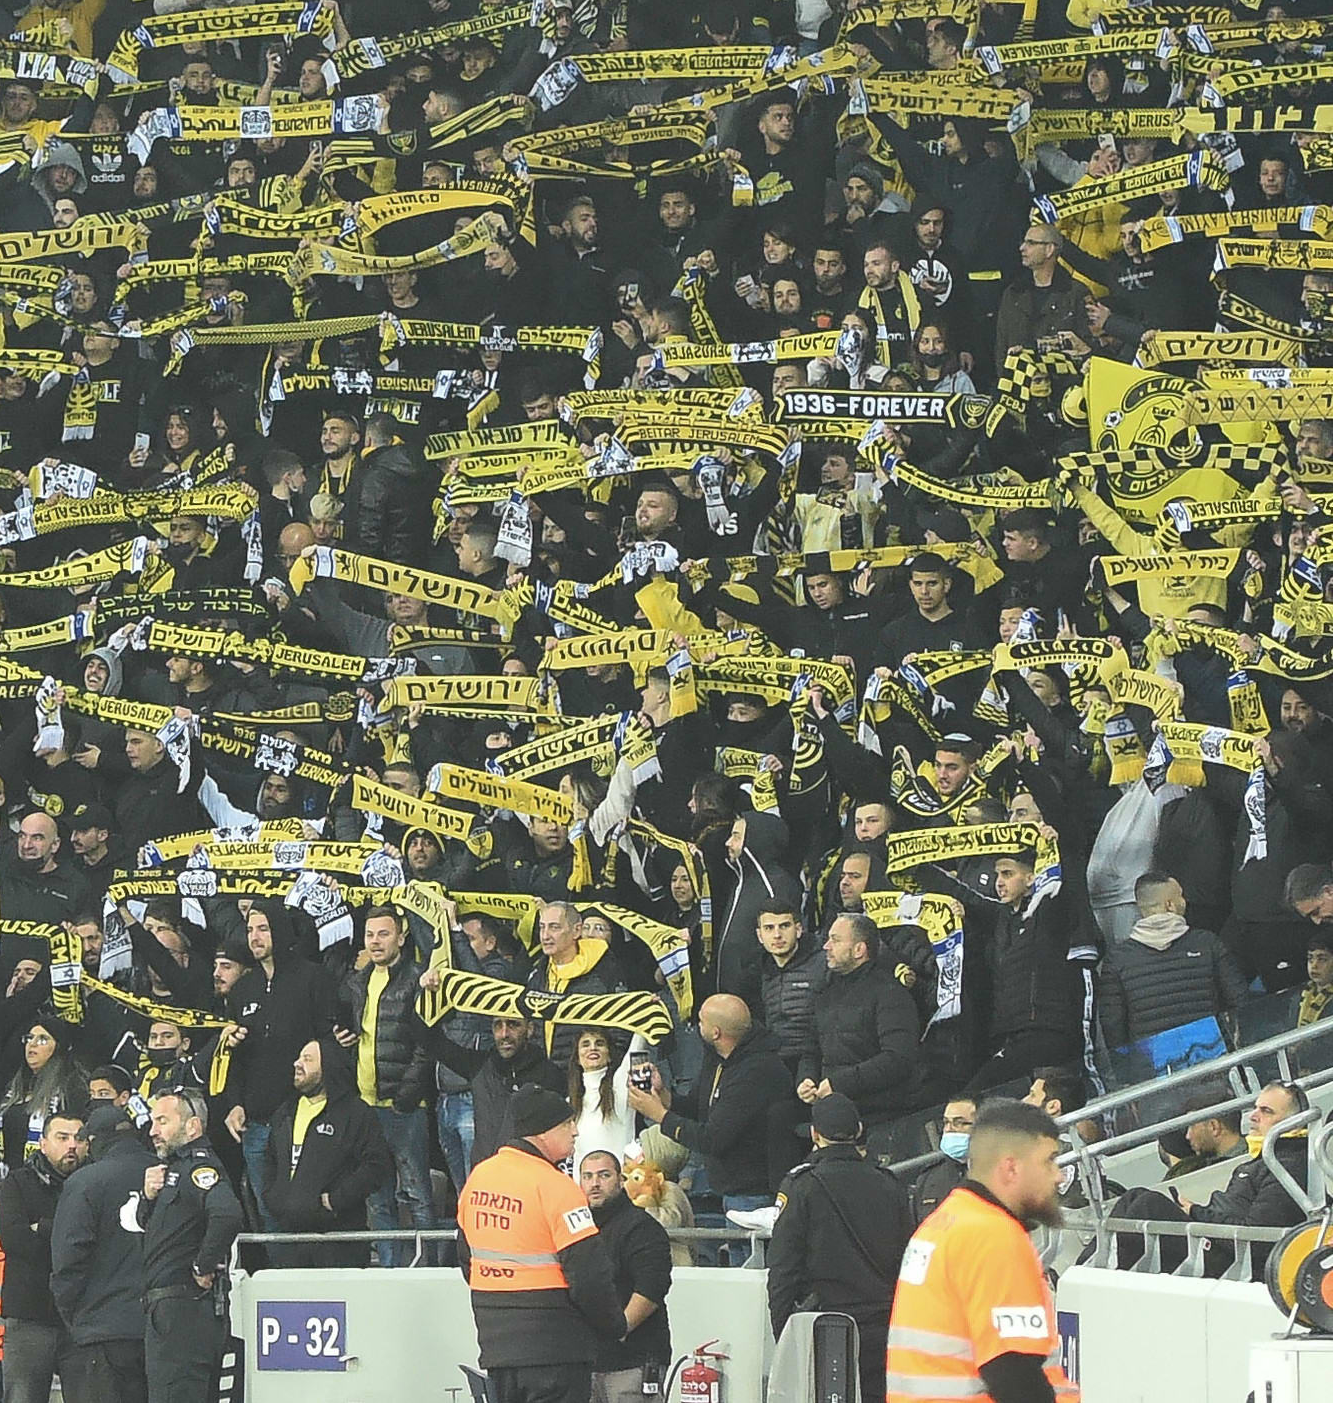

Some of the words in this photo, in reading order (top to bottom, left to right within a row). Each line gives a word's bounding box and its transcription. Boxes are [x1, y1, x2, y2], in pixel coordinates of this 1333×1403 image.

[380, 33, 441, 53] ירושלים
[469, 5, 532, 29] JERUSALEM
[18, 53, 57, 78] LIA
[869, 96, 943, 110] ירושלים
[514, 127, 595, 149] ירושלים
[91, 174, 125, 184] adidas
[406, 322, 476, 340] JERUSALEM
[518, 330, 587, 347] ירושלים
[1167, 337, 1280, 355] ירושלים
[786, 394, 942, 419] 1936-FOREVER
[640, 428, 681, 438] BEITAR
[689, 429, 760, 444] JERUSALEM
[463, 456, 520, 471] ירושלים
[1112, 557, 1173, 575] ירושלים
[368, 566, 494, 609] ירושלים
[152, 625, 221, 647] ירושלים
[275, 646, 364, 673] JERUSALEM
[406, 681, 520, 701] ירושלים
[99, 701, 170, 727] JERUSALEM
[449, 776, 512, 801] ירושלים
[359, 785, 417, 817] ירושלים
[470, 1194, 522, 1211] התאמה
[476, 1213, 510, 1229] סדרן
[994, 1314, 1043, 1328] סדרן
[261, 1319, 281, 1355] P
[306, 1317, 339, 1355] 32
